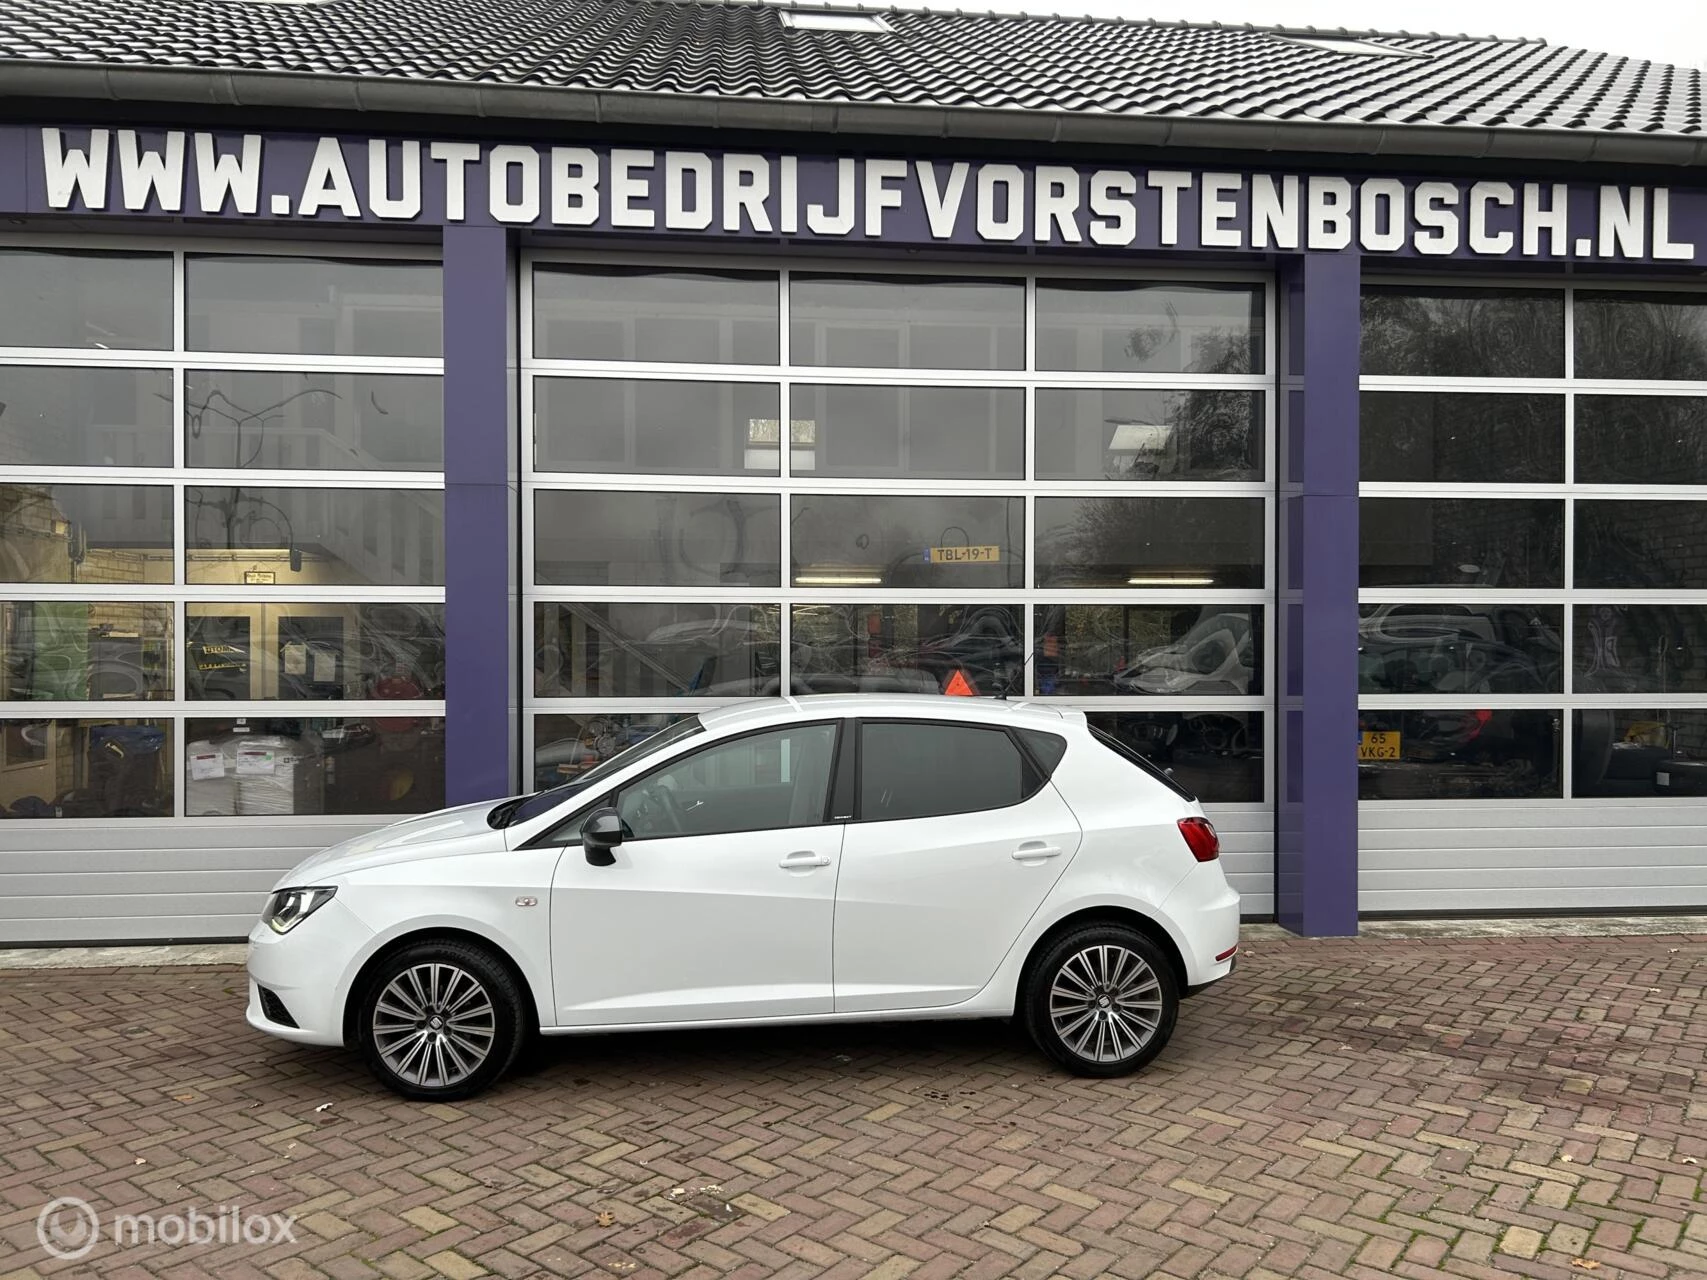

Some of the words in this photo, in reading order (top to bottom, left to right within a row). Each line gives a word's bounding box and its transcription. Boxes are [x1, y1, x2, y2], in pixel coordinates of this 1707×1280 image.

[42, 127, 1695, 261] WWW.AUTOBEDRIJFVORSTENBOSCH.NL
[937, 547, 993, 561] TBL-19-T
[1370, 733, 1386, 744] 65
[1360, 746, 1396, 758] VKG-2
